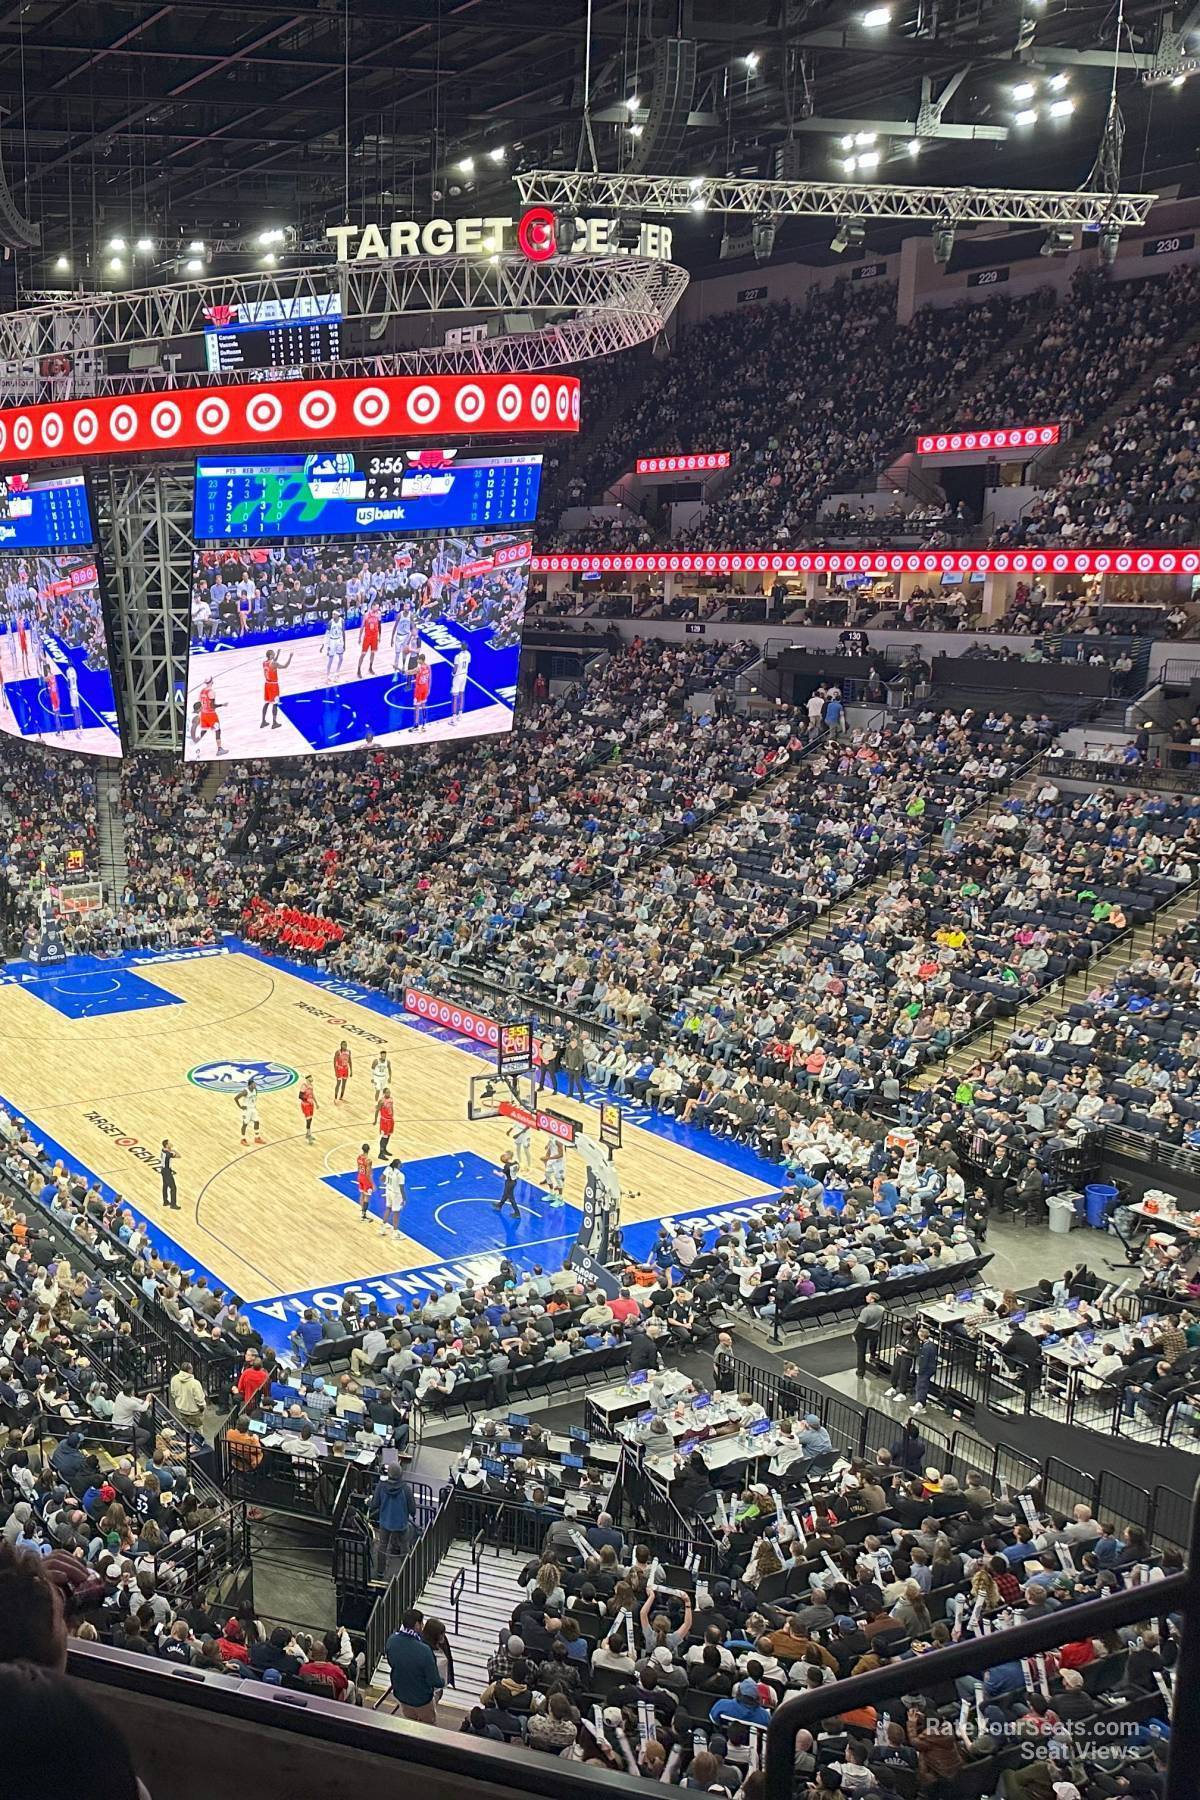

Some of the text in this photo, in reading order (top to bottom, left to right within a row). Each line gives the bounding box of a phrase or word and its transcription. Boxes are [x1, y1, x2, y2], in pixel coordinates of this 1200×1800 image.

[326, 217, 673, 262] TARGET CETER
[1156, 239, 1179, 253] 230
[978, 272, 997, 284] 229
[369, 457, 403, 474] 3:56
[488, 469, 494, 477] 0
[227, 479, 234, 487] 4
[245, 478, 250, 486] 2
[279, 477, 285, 486] 0
[487, 479, 494, 488] 12
[514, 478, 519, 486] 2
[208, 491, 218, 499] 27
[227, 491, 233, 499] 5
[244, 490, 250, 498] 3
[368, 488, 400, 499] 6 2 4
[486, 490, 493, 498] 15
[226, 502, 232, 510] 5
[277, 501, 283, 509] 0
[485, 501, 491, 509] 8
[511, 499, 517, 507] 3
[524, 498, 529, 506] 0
[225, 513, 232, 522] 3
[243, 513, 249, 521] 0
[276, 512, 282, 520] 0
[484, 511, 490, 520] 5
[510, 510, 515, 518] 4
[225, 525, 231, 533] 4
[243, 525, 248, 533] 3
[848, 632, 861, 641] 130
[67, 857, 81, 869] 24
[132, 947, 231, 966] betway
[295, 1000, 388, 1045] TARGET CENTER
[82, 1110, 127, 1137] TARGET
[571, 1261, 599, 1283] TARGET
[350, 1319, 360, 1332] 21
[136, 1498, 148, 1514] 32
